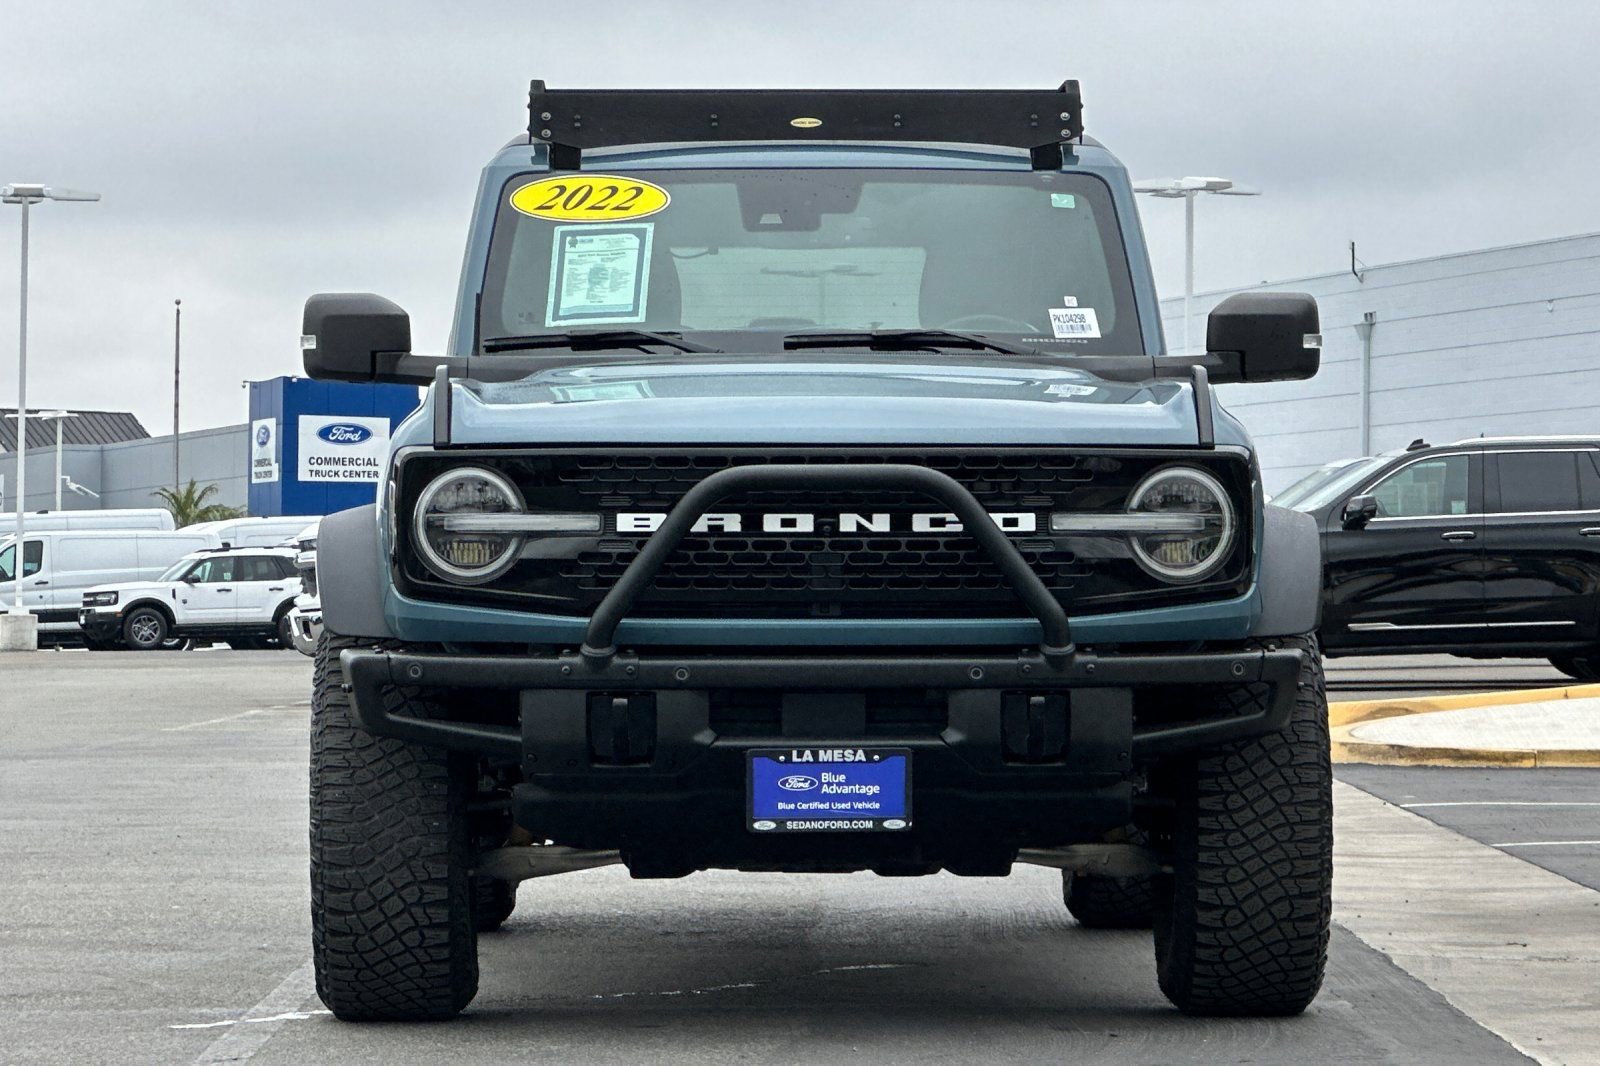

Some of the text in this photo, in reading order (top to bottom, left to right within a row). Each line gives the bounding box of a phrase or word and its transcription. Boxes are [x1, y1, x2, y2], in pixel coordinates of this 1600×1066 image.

[533, 184, 644, 211] 2022
[328, 426, 362, 441] Ford
[308, 456, 379, 467] COMMERCIAL
[308, 469, 379, 479] TRUCK CENTER
[616, 513, 1036, 532] BRONCO
[792, 749, 866, 762] LA MESA
[785, 772, 846, 789] Ford Blue
[821, 783, 880, 796] Advantage
[777, 801, 881, 810] Blue Certified Used Vehicle
[786, 820, 874, 830] SEDANOFORD.COM
